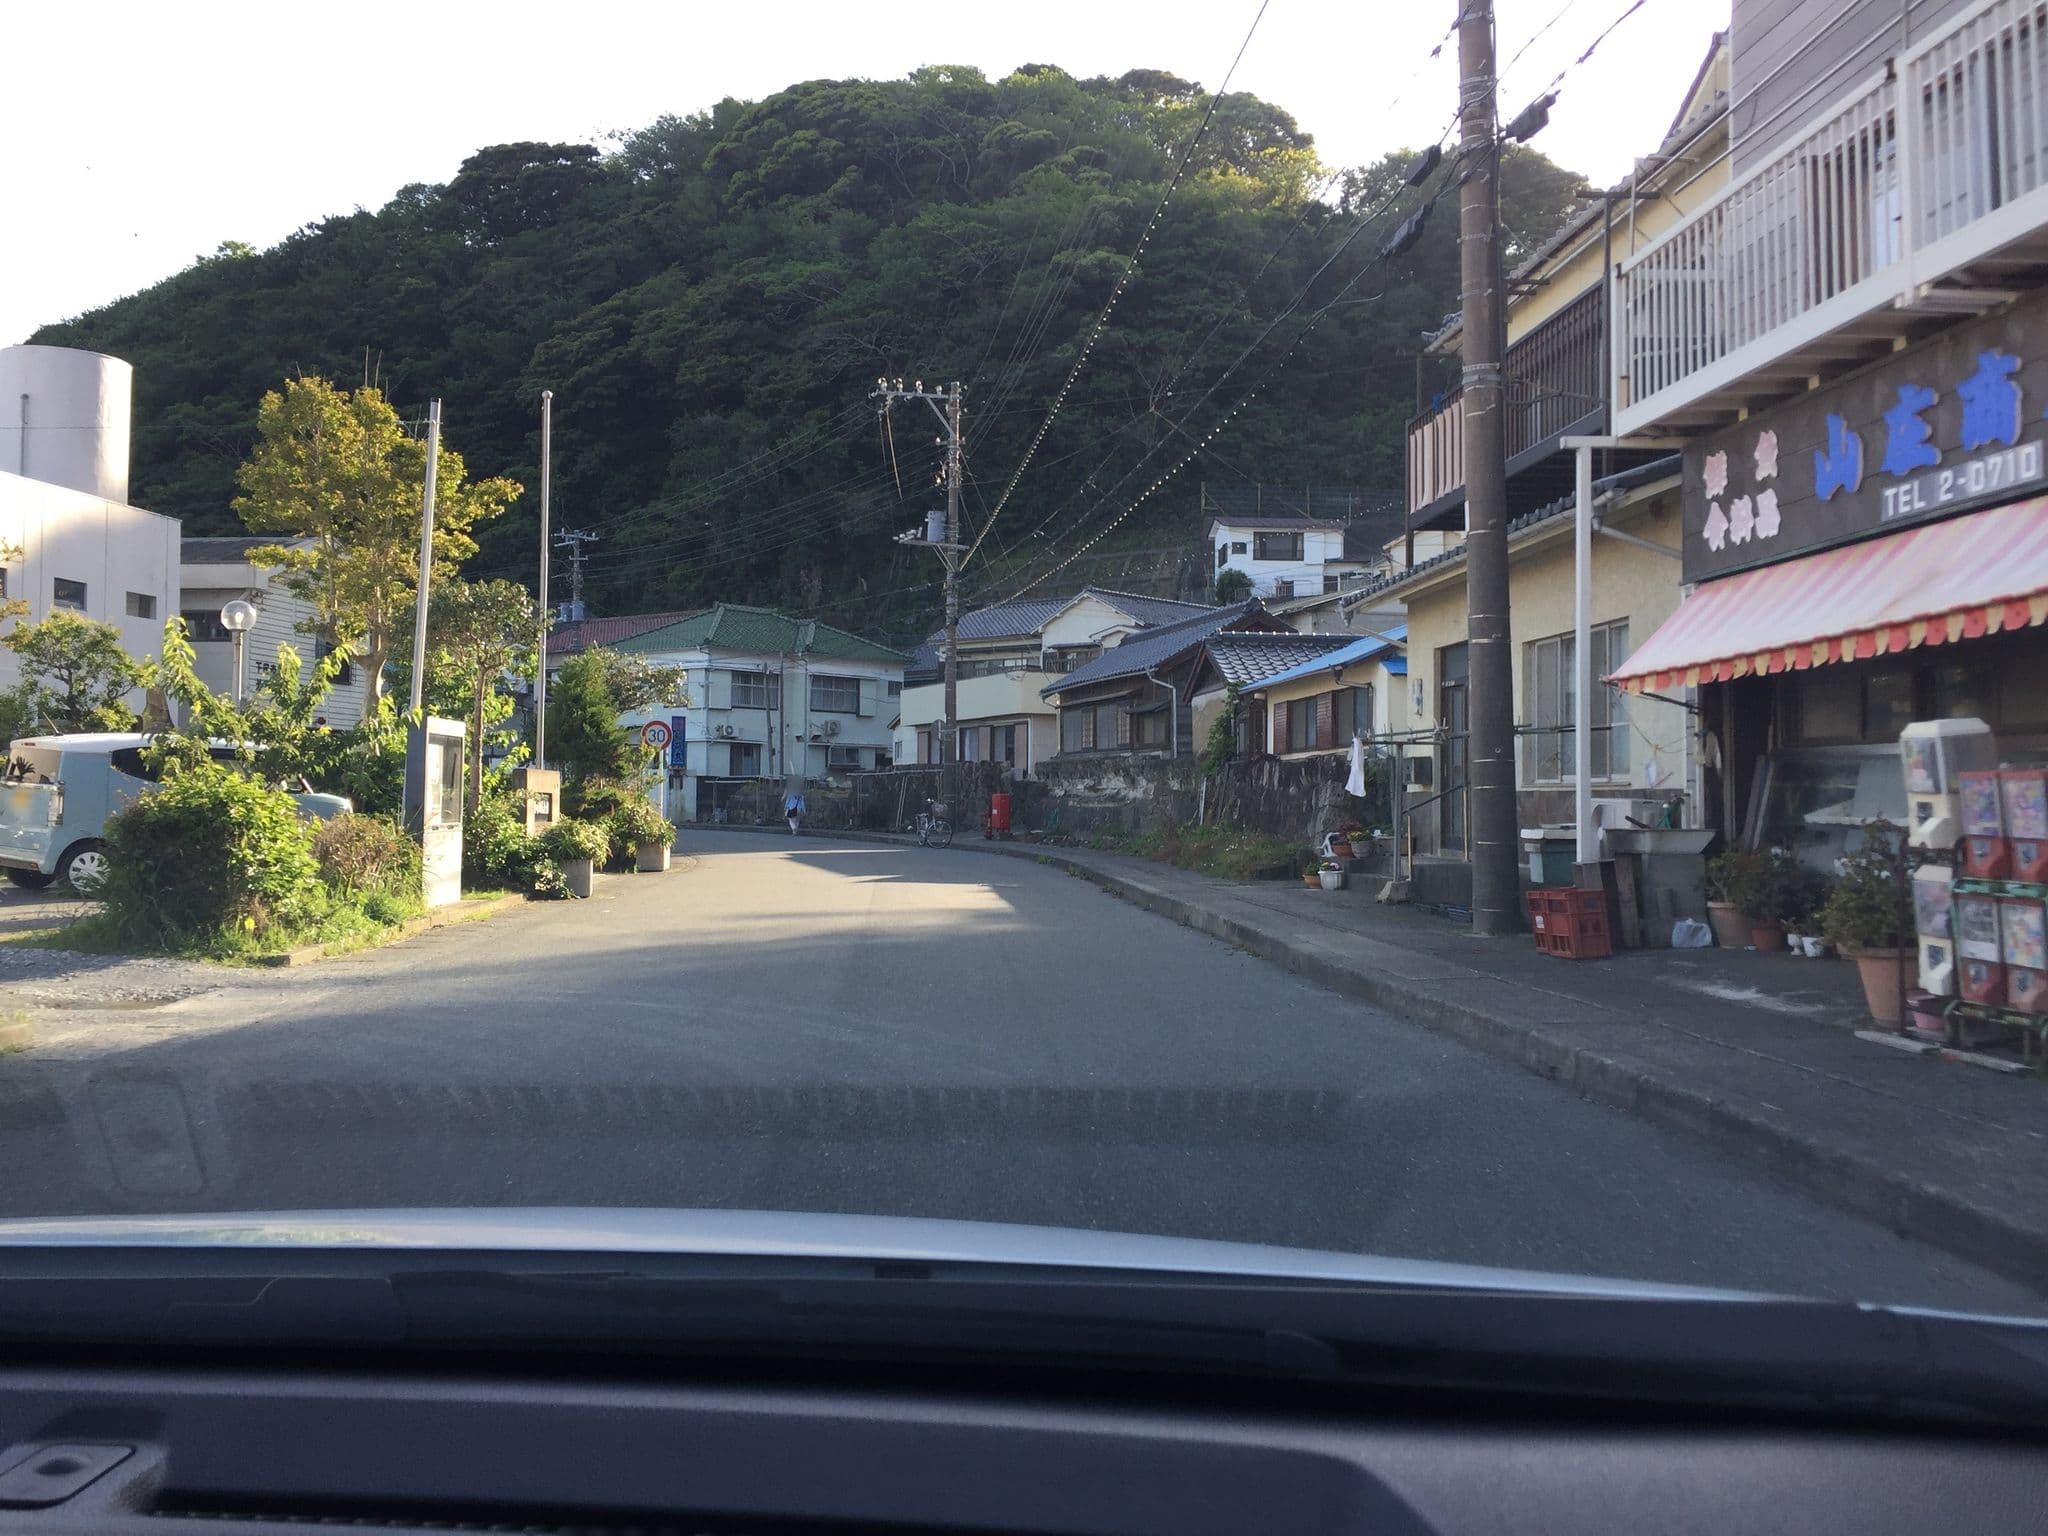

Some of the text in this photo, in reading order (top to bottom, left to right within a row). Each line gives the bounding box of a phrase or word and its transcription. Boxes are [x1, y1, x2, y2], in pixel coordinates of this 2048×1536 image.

[1884, 446, 2037, 517] TEL 2-0710
[648, 729, 665, 742] 30
